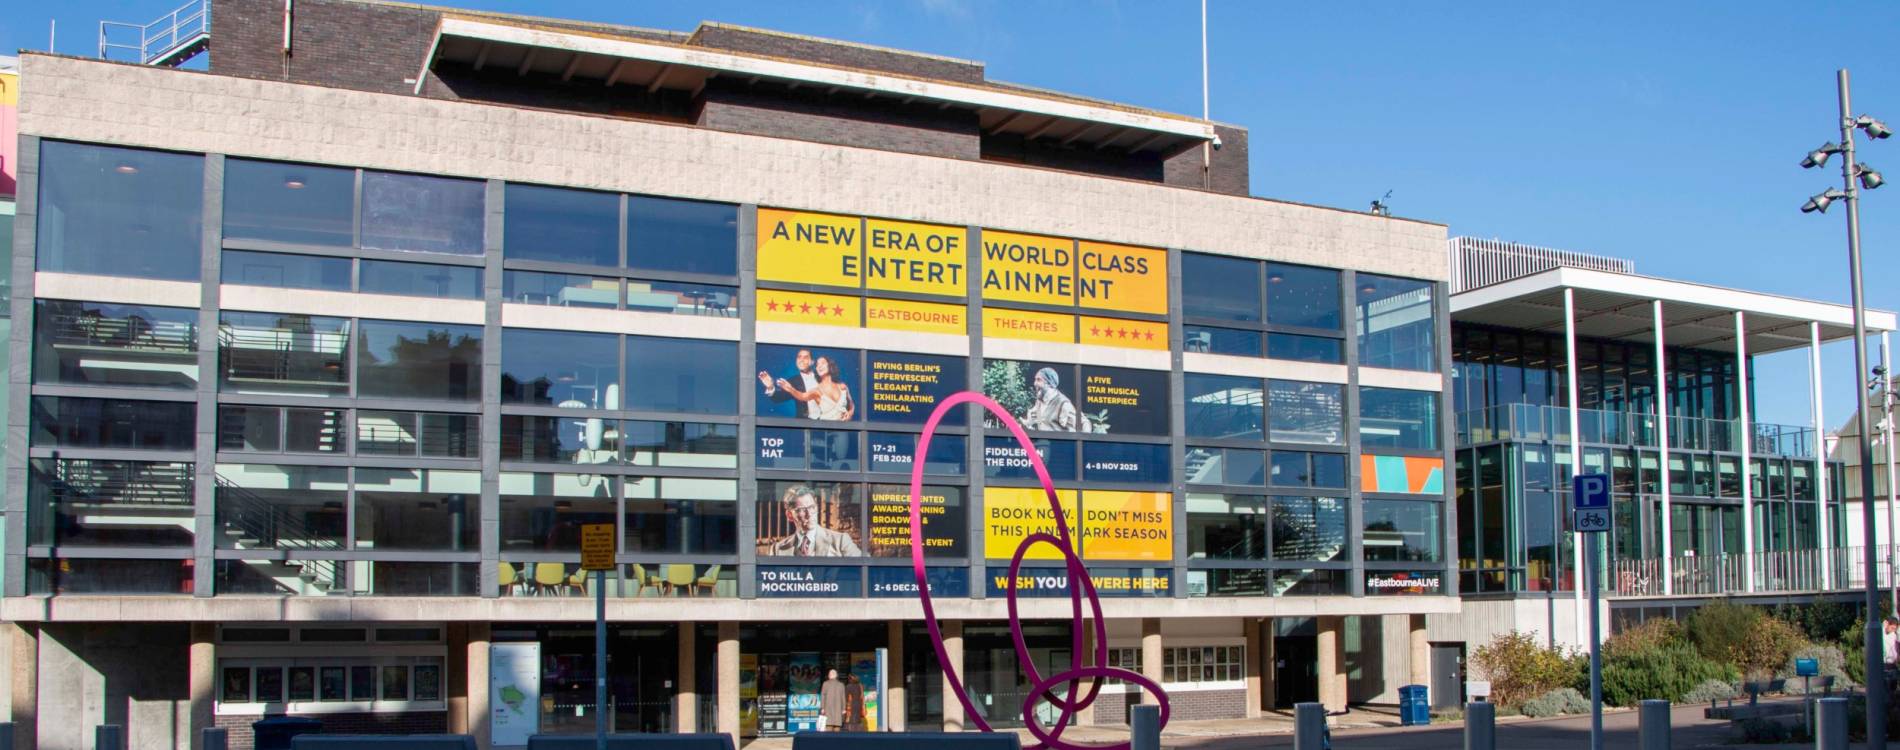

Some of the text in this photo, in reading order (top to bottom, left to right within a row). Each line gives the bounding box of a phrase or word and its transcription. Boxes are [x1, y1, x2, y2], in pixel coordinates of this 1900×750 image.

[772, 221, 1148, 275] A NEW ERA OF WORLD CLASS
[869, 308, 1058, 333] EASTBOURNE THEATRES
[874, 362, 941, 372] IRVING BERLIN'S
[874, 372, 938, 384] EFFERVESCENT,
[1087, 376, 1093, 384] A
[874, 383, 912, 392] ELEGANT
[1107, 387, 1139, 396] MUSICAL
[874, 393, 934, 403] EXHILARATING
[1087, 396, 1137, 406] MASTERPIECE
[874, 403, 911, 413] MUSICAL
[761, 438, 784, 447] TOP
[761, 449, 784, 458] HAT
[985, 447, 1027, 457] FIDDLER
[873, 454, 912, 463] FEB 2026
[986, 457, 1004, 467] THE
[1120, 463, 1138, 471] 2025
[1582, 478, 1603, 505] P
[991, 508, 1032, 519] BOOK
[1087, 510, 1128, 522] DON'T
[1132, 511, 1162, 523] MISS
[872, 527, 911, 535] WEST EN
[991, 525, 1023, 536] THIS
[1114, 528, 1167, 539] SEASON
[926, 539, 953, 547] EVENT
[761, 571, 814, 580] TO KILL A
[994, 576, 1168, 590] WSH YOU WERE HERE
[1368, 578, 1439, 587] #EastbourneALIVE
[761, 583, 839, 592] MOCKINGBIRD
[892, 583, 910, 592] DEC
